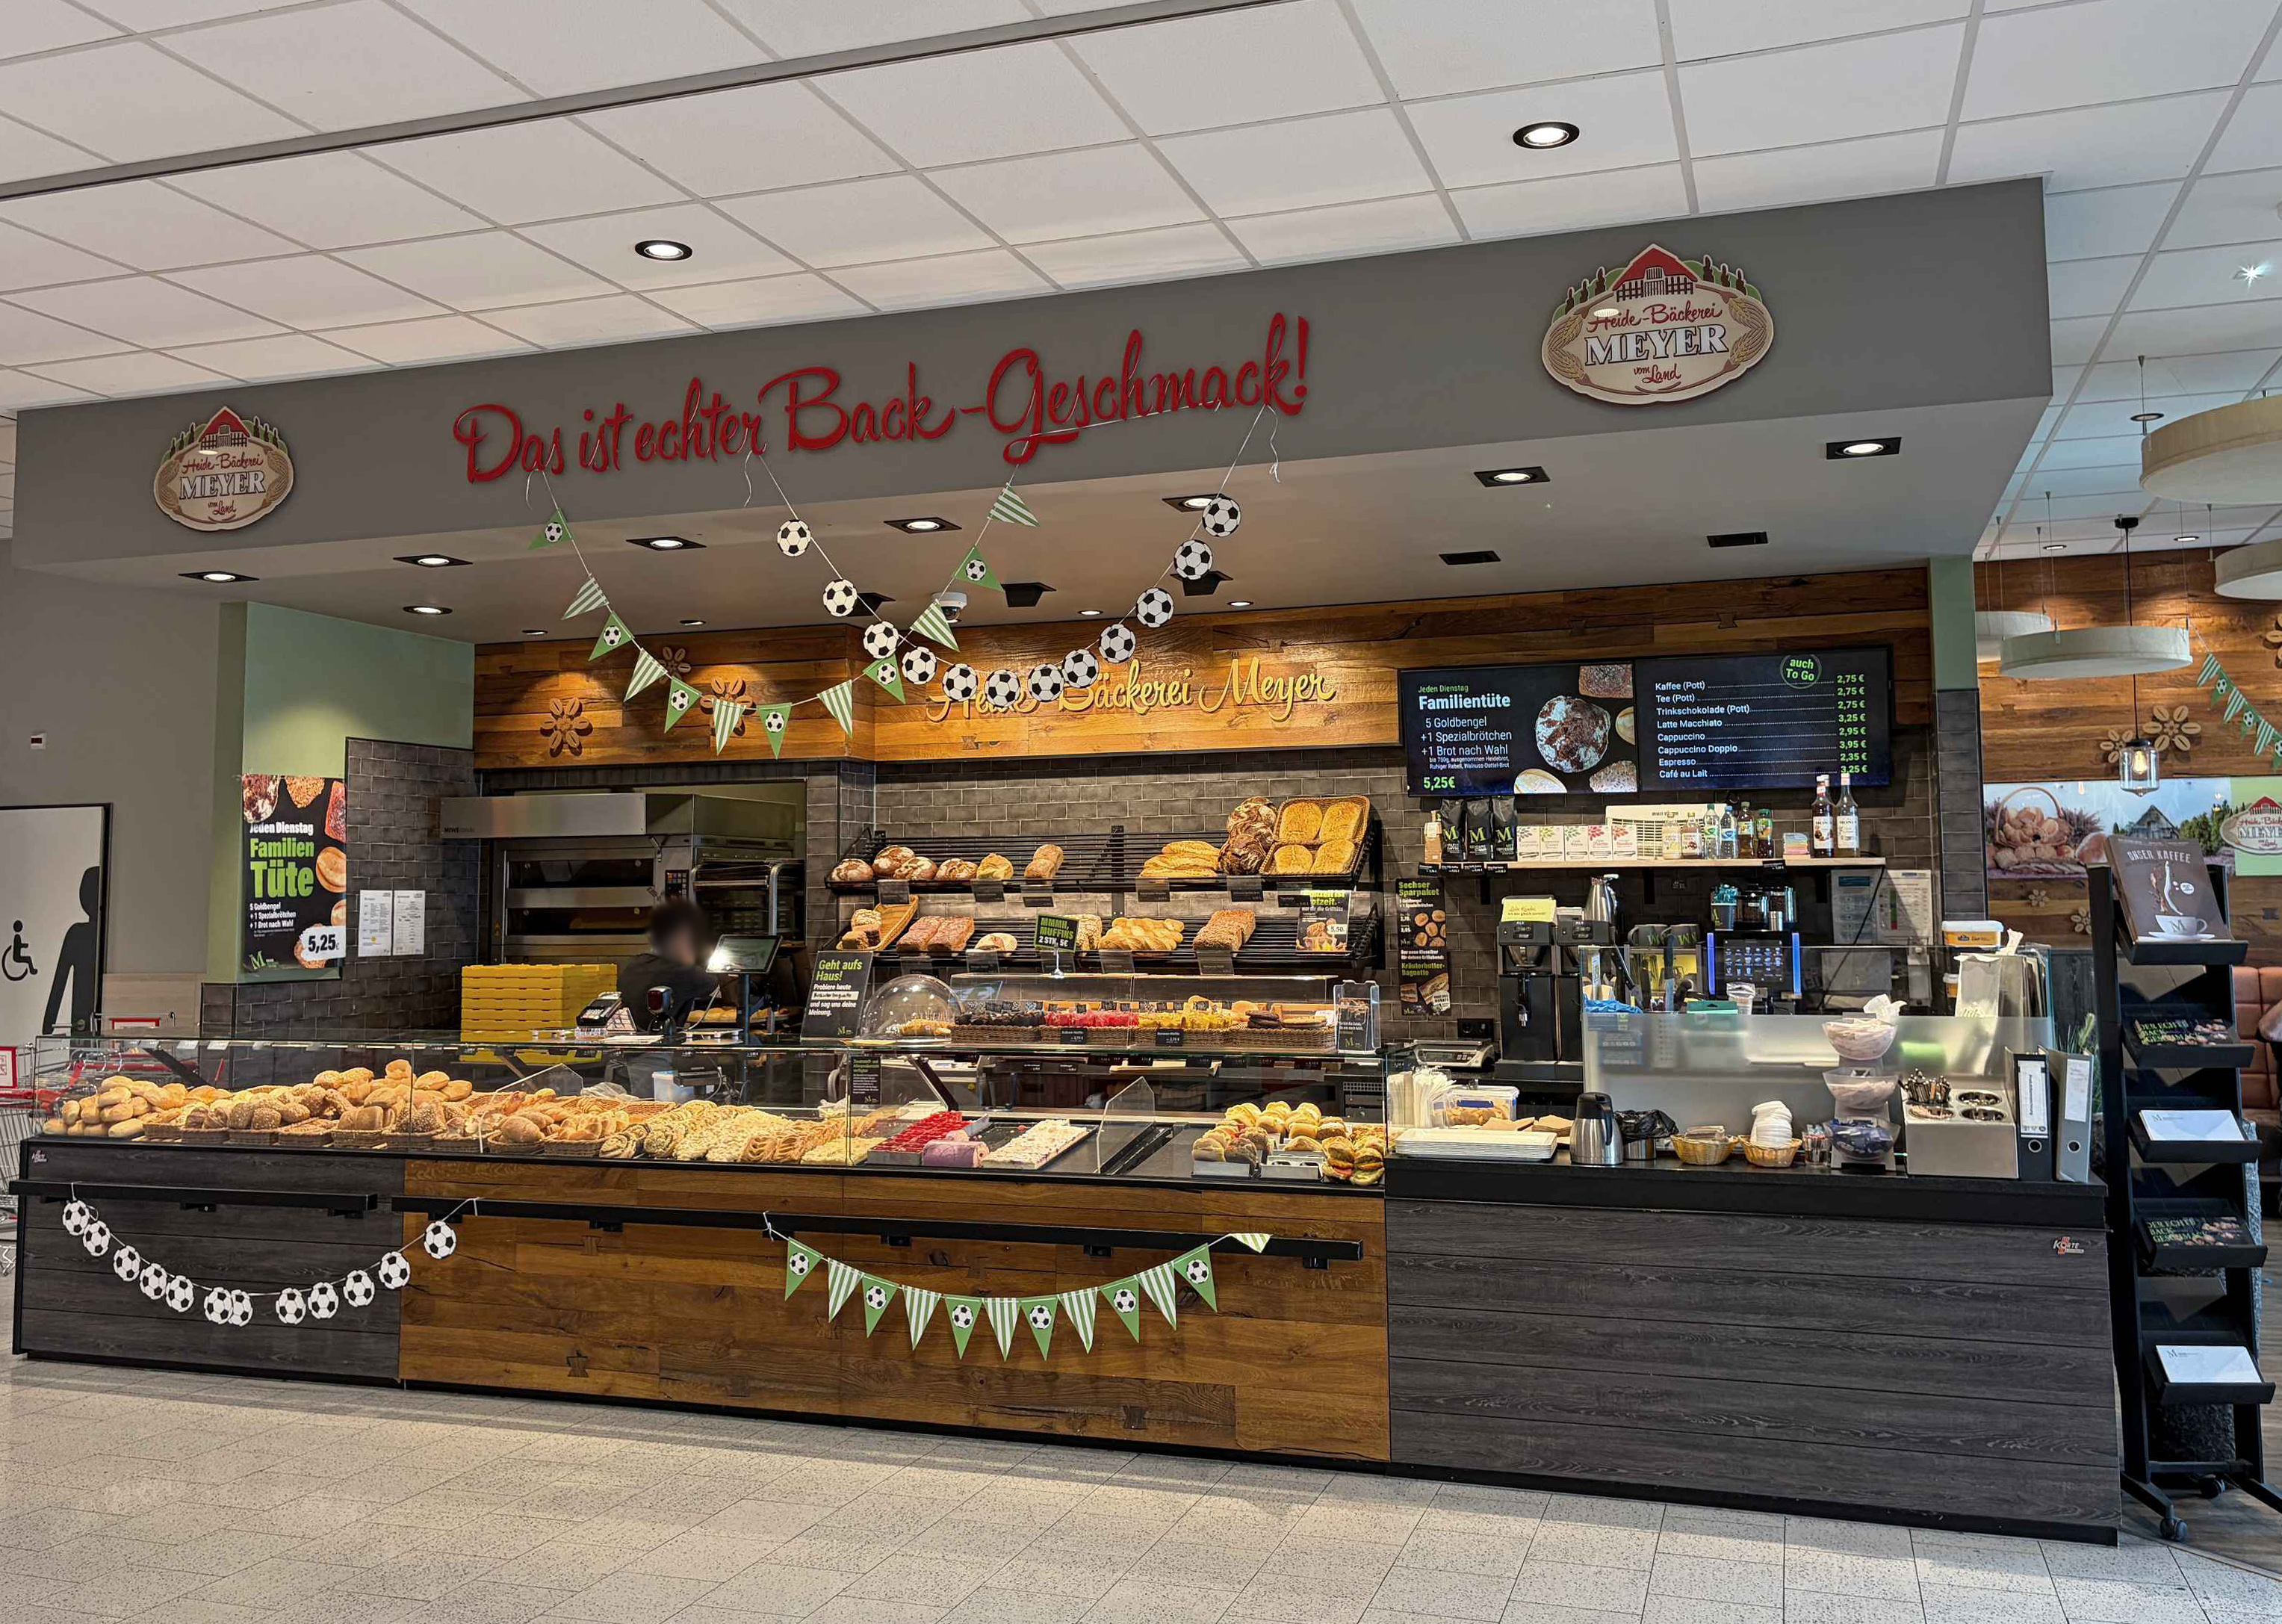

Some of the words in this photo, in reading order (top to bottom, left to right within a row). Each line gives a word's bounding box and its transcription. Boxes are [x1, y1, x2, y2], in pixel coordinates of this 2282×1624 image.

[1587, 300, 1723, 332] Heide-Bäckerei
[1585, 324, 1729, 366] MEYER
[1634, 367, 1650, 376] vom
[1642, 364, 1681, 383] Land
[453, 403, 565, 483] Das
[579, 403, 634, 472] ist
[634, 376, 768, 462] echter
[757, 312, 1310, 465] Back-Geschmack!
[183, 452, 264, 474] Heide-Bäckerei
[179, 470, 266, 500] MEYER
[213, 500, 237, 515] Land
[1790, 659, 1814, 669] auch
[1786, 668, 1799, 678] To
[1800, 670, 1815, 681] Go
[1058, 658, 1194, 715] Bäckerei
[1198, 657, 1337, 722] Meyer
[1439, 685, 1469, 693] Dienstag
[1655, 682, 1681, 690] Kaffee
[1682, 681, 1705, 691] (Pott)
[1837, 675, 1857, 684] 2,75
[1858, 674, 1865, 683] €
[1419, 693, 1511, 710] Familientüte
[1672, 693, 1696, 704] (Pott)
[1837, 687, 1857, 697] 2,75
[1858, 687, 1865, 695] €
[1656, 706, 1726, 716] Trinkschokolade
[1726, 704, 1750, 715] (Pott)
[1838, 701, 1858, 710] 2,75
[1858, 700, 1866, 708] €
[1425, 718, 1432, 728] 5
[1434, 716, 1487, 729] Goldbengel
[1657, 720, 1678, 728] Latte
[1679, 719, 1723, 728] Macchiato
[1838, 713, 1858, 723] 3,25
[1859, 713, 1866, 722] €
[1436, 730, 1513, 744] Spezialbrötchen
[1658, 733, 1706, 743] Cappuccino
[1838, 727, 1858, 737] 2,95
[1860, 726, 1867, 735] €
[1436, 746, 1457, 756] Brot
[1459, 745, 1482, 755] nach
[1484, 744, 1508, 754] Wahl
[1658, 746, 1707, 755] Cappuccino
[1708, 744, 1738, 754] Doppio
[1839, 740, 1859, 750] 3,95
[1860, 740, 1867, 749] €
[1658, 758, 1696, 767] Espresso
[1840, 753, 1860, 762] 2,35
[1861, 752, 1867, 760] €
[1659, 769, 1678, 778] Café
[1692, 769, 1708, 778] Lait
[1841, 765, 1860, 774] 3,25
[1861, 764, 1868, 773] €
[1423, 777, 1456, 791] 5,25€
[249, 822, 276, 834] Jeden
[276, 821, 314, 836] Dienstag
[1442, 825, 1459, 842] M
[1469, 826, 1486, 843] M
[1495, 826, 1513, 843] M
[2237, 825, 2282, 838] MEYE
[250, 837, 314, 858] Familien
[2127, 850, 2154, 861] UNSER
[2156, 850, 2192, 864] KAFFEE
[250, 859, 314, 898] Tüte
[1398, 888, 1440, 897] Sparpaket
[254, 902, 281, 911] Goldbengel
[258, 911, 297, 920] Spezialbrötchen
[269, 920, 281, 929] nach
[2170, 919, 2186, 932] M
[1038, 935, 1044, 943] 2
[1040, 926, 1073, 940] MUFFINS
[308, 934, 336, 954] 5,25
[819, 959, 840, 970] Geht
[842, 959, 863, 970] aufs
[816, 971, 843, 981] Haus!
